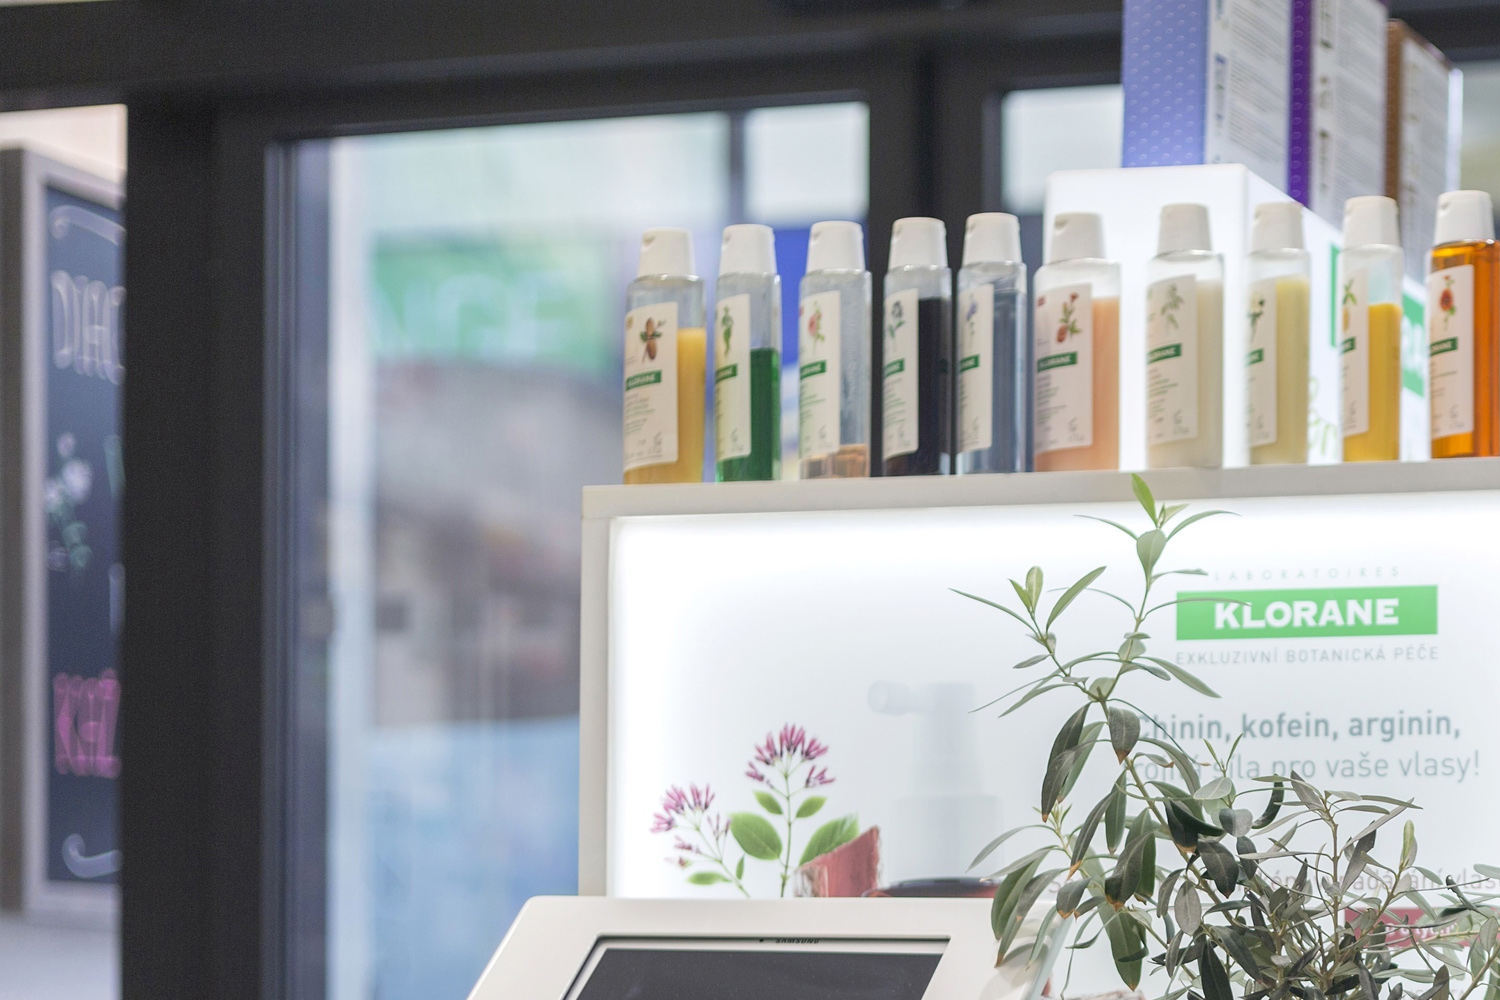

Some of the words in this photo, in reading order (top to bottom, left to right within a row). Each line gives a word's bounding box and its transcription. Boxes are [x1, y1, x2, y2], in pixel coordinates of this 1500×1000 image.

[1214, 565, 1400, 582] LABORATOIRES
[1214, 597, 1400, 630] KLORANE
[1176, 647, 1278, 665] EXKLUZIVNÍ
[1286, 643, 1386, 663] BOTANICKÁ
[1394, 642, 1439, 661] PÉČE
[1241, 711, 1339, 742] kofein,
[1349, 710, 1462, 743] arginin,
[1271, 758, 1316, 780] pro
[1325, 751, 1389, 778] vaše
[1398, 749, 1480, 784] vlasy!
